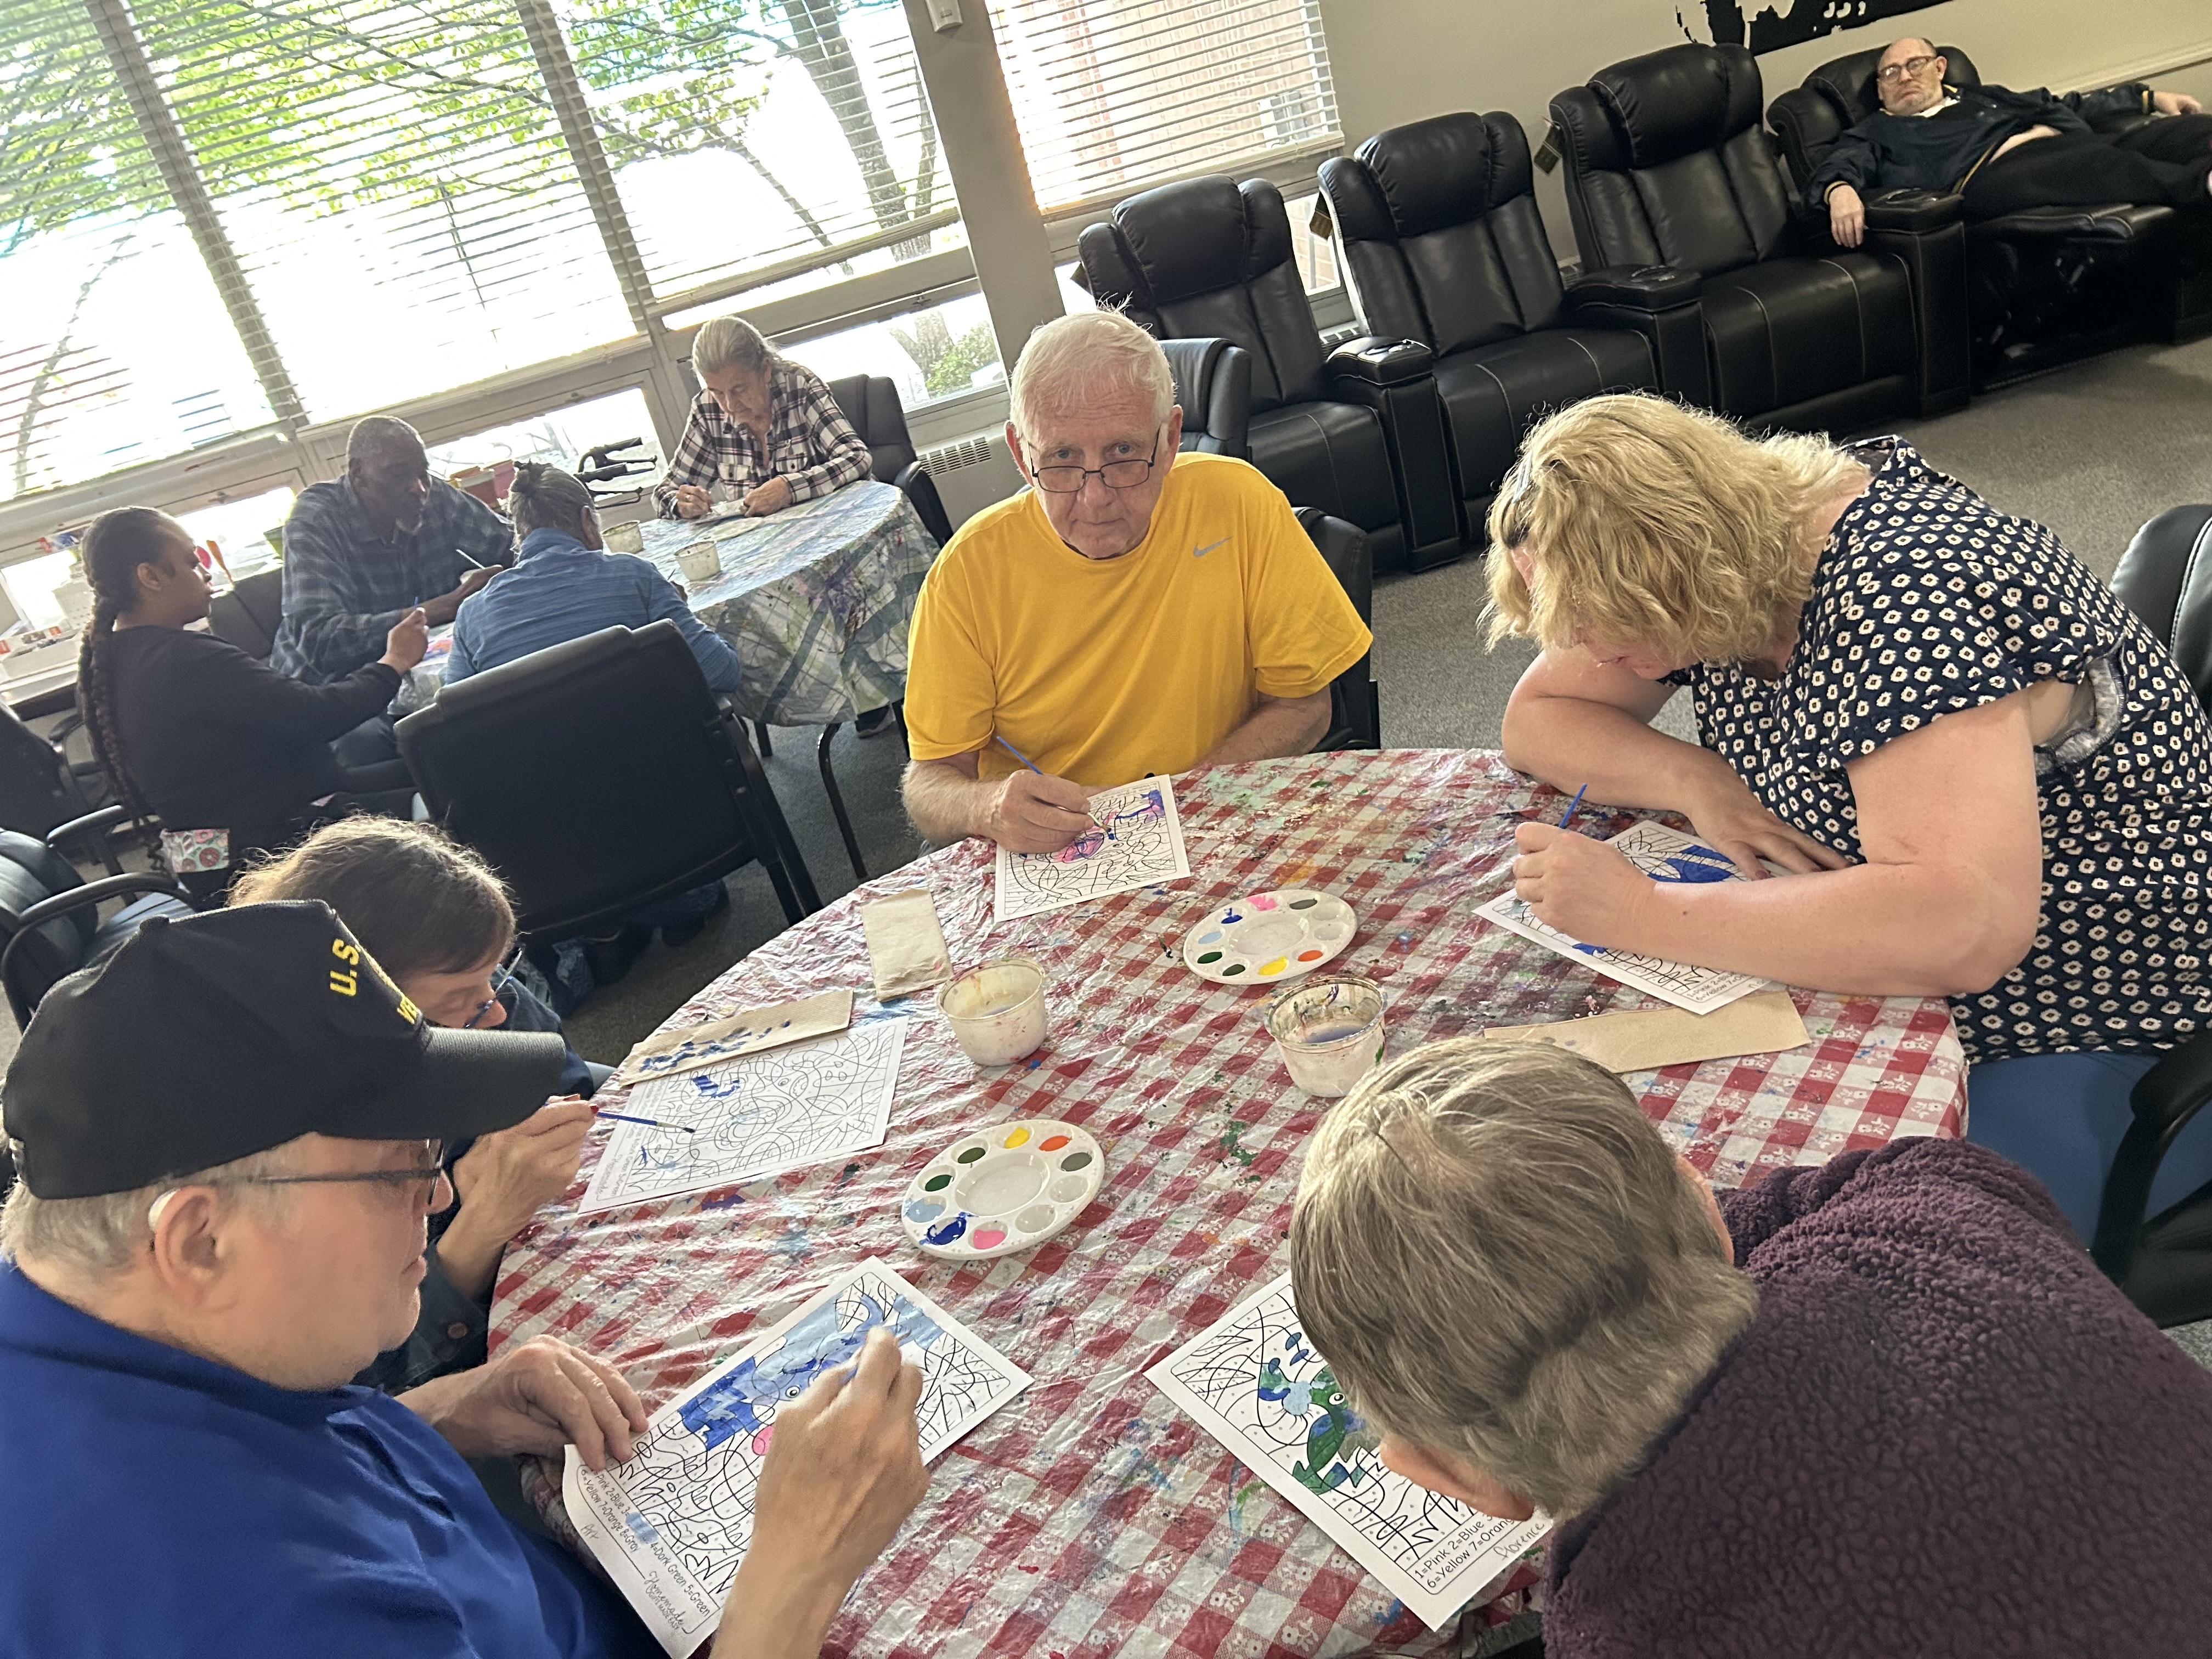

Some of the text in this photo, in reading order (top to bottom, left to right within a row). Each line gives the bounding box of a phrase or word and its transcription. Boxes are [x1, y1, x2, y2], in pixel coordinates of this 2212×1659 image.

[581, 1469, 601, 1503] 6=Yellow
[599, 1501, 623, 1531] 7=Orange
[620, 1528, 640, 1553] 8=Gray
[606, 1488, 624, 1509] 2=Blue
[651, 1542, 710, 1617] 4=Dark Green 5=Green
[1415, 1520, 1484, 1578] 1=Pink 2=Blue
[1427, 1517, 1515, 1588] 6=Yellow 7=Orang
[644, 1571, 685, 1626] Homemade
